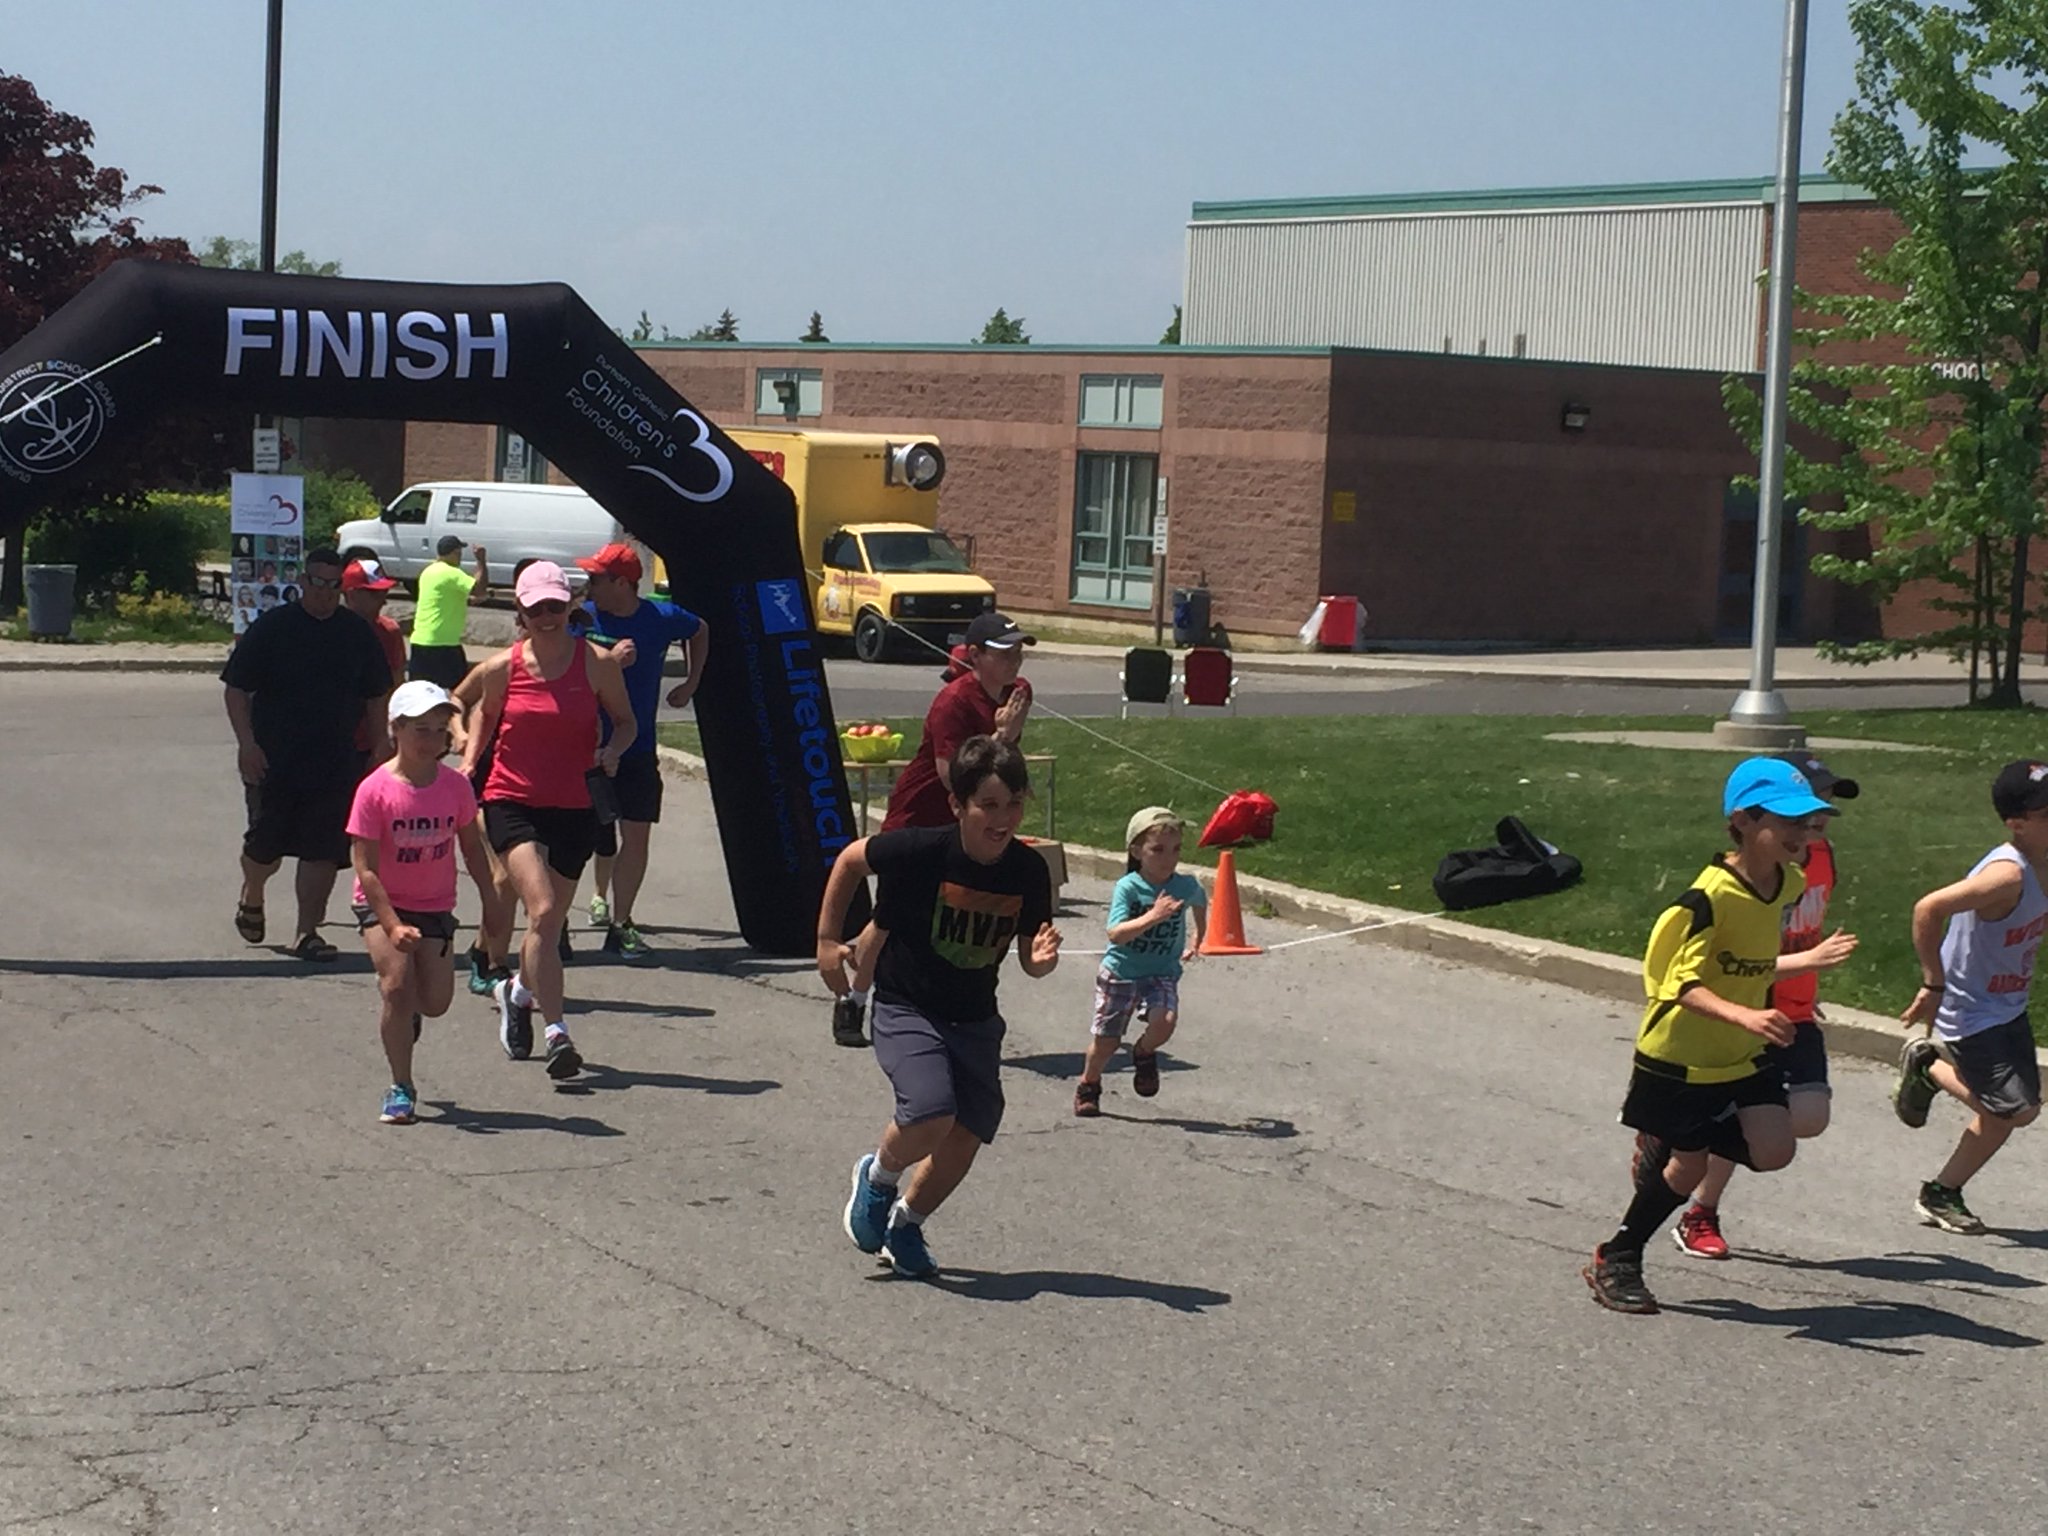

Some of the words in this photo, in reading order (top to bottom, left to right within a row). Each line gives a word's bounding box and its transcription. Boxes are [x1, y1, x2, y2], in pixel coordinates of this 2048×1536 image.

[46, 359, 90, 376] SCHOO
[224, 307, 509, 380] FINISH
[566, 387, 642, 459] Foundation
[582, 369, 678, 458] Children's
[939, 903, 1014, 949] MVP
